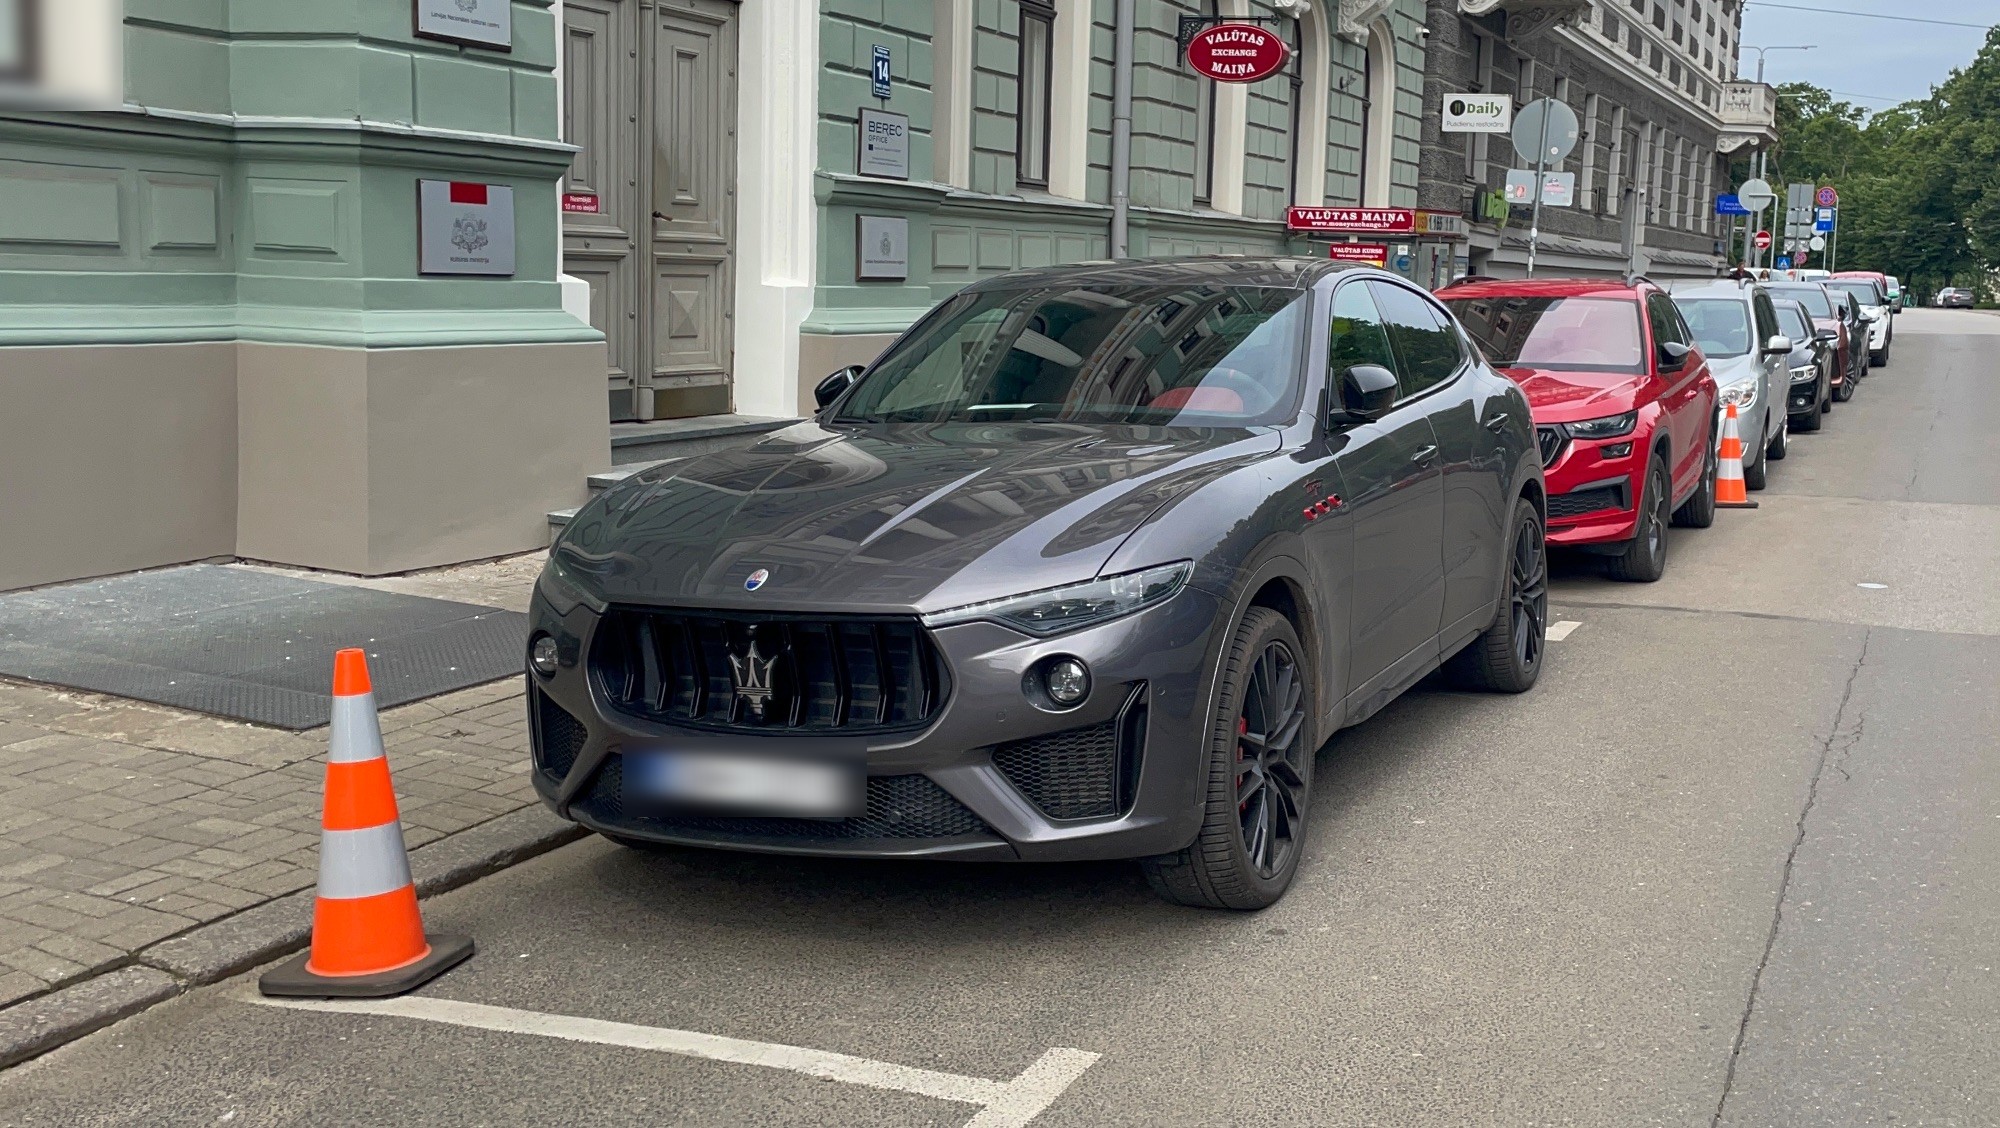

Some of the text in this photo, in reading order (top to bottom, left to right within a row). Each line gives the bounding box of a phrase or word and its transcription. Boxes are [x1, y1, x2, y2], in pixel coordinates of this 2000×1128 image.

[1205, 29, 1265, 46] VALŪTAS
[1211, 48, 1258, 57] EXCHANGE
[876, 60, 889, 82] 14
[1211, 61, 1256, 77] MAIŅA
[1467, 101, 1503, 118] Daily
[868, 120, 903, 137] BEREC
[868, 134, 888, 144] OFFICE
[1297, 210, 1406, 224] VALŪTAS MAIŅA
[1311, 220, 1390, 229] www.moneyexchange.lv
